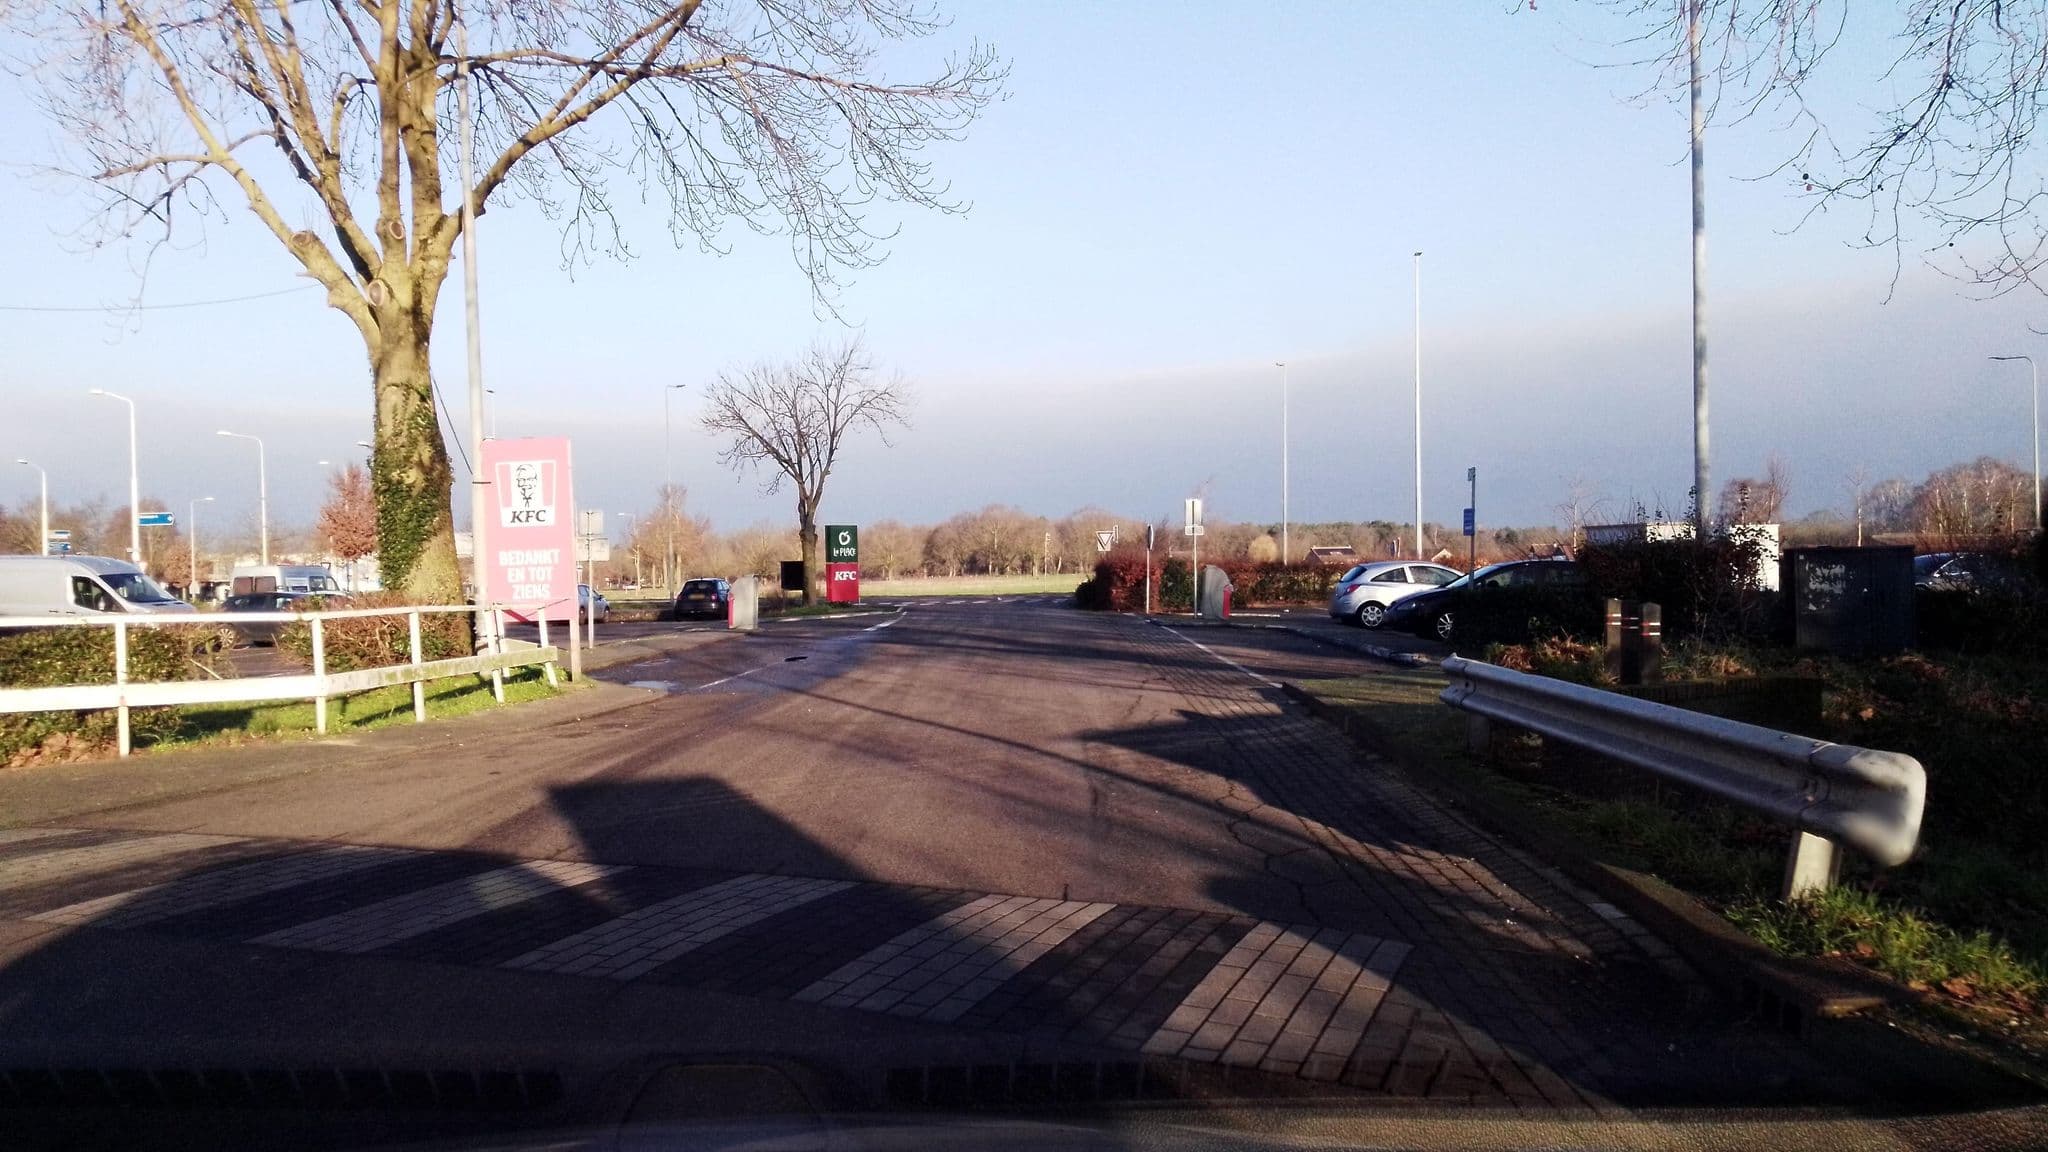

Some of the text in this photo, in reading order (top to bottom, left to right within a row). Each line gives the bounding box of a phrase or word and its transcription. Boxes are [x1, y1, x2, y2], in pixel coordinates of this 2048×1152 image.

[510, 509, 546, 524] KFC
[500, 550, 560, 566] BEDANKT
[840, 547, 856, 556] PLACE
[508, 567, 553, 583] EN TOT
[834, 571, 856, 581] KFC
[512, 584, 550, 600] ZIENS
